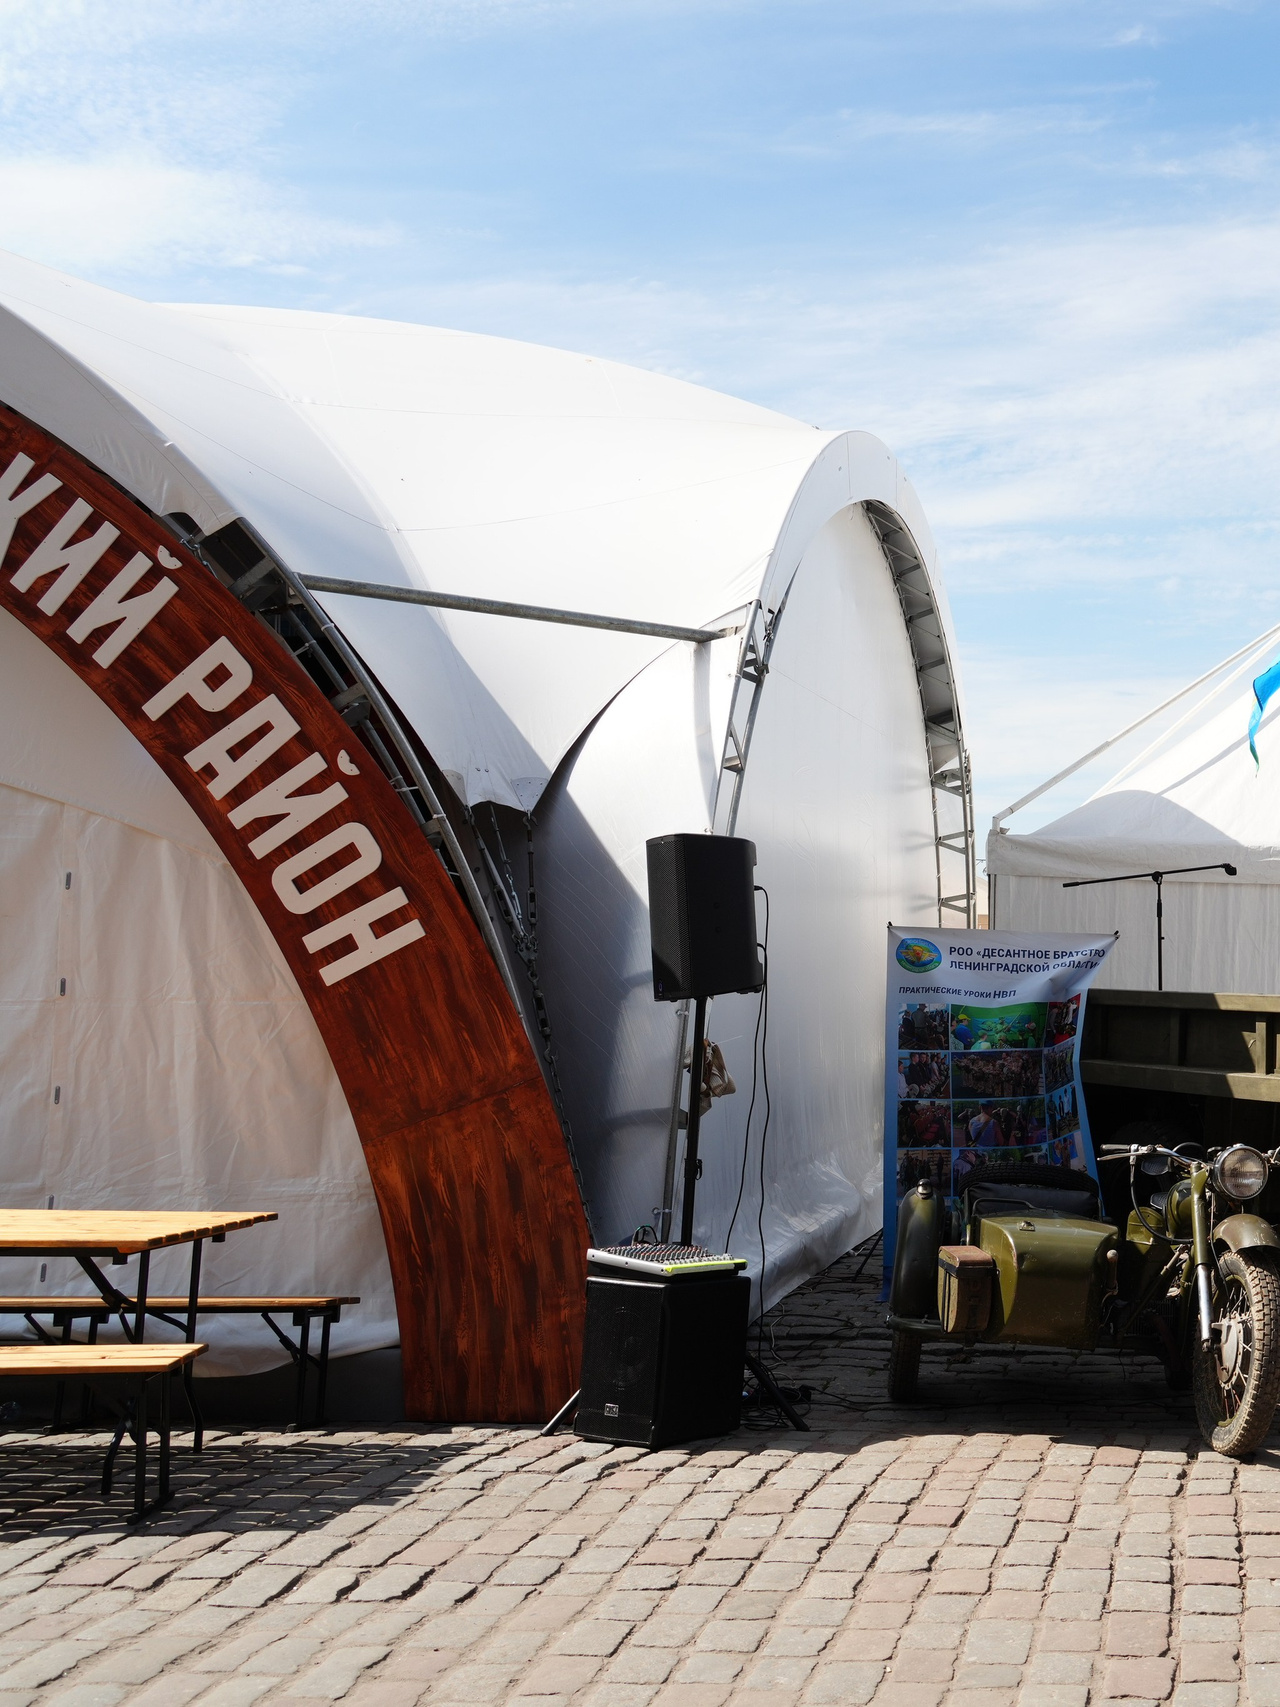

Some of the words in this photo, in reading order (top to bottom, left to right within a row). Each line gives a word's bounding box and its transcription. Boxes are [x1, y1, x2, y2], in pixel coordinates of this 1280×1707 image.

[142, 636, 426, 987] РАЙОН
[949, 946, 974, 957] РОО
[976, 947, 1051, 960] «ДЕСАНТНОЕ
[949, 960, 1050, 974] ЛЕНИНГРАДСКОЙ
[898, 986, 962, 996] ПРАКТИЧЕСКИЕ
[963, 989, 992, 999] УРОКИ
[992, 989, 1017, 999] НВП
